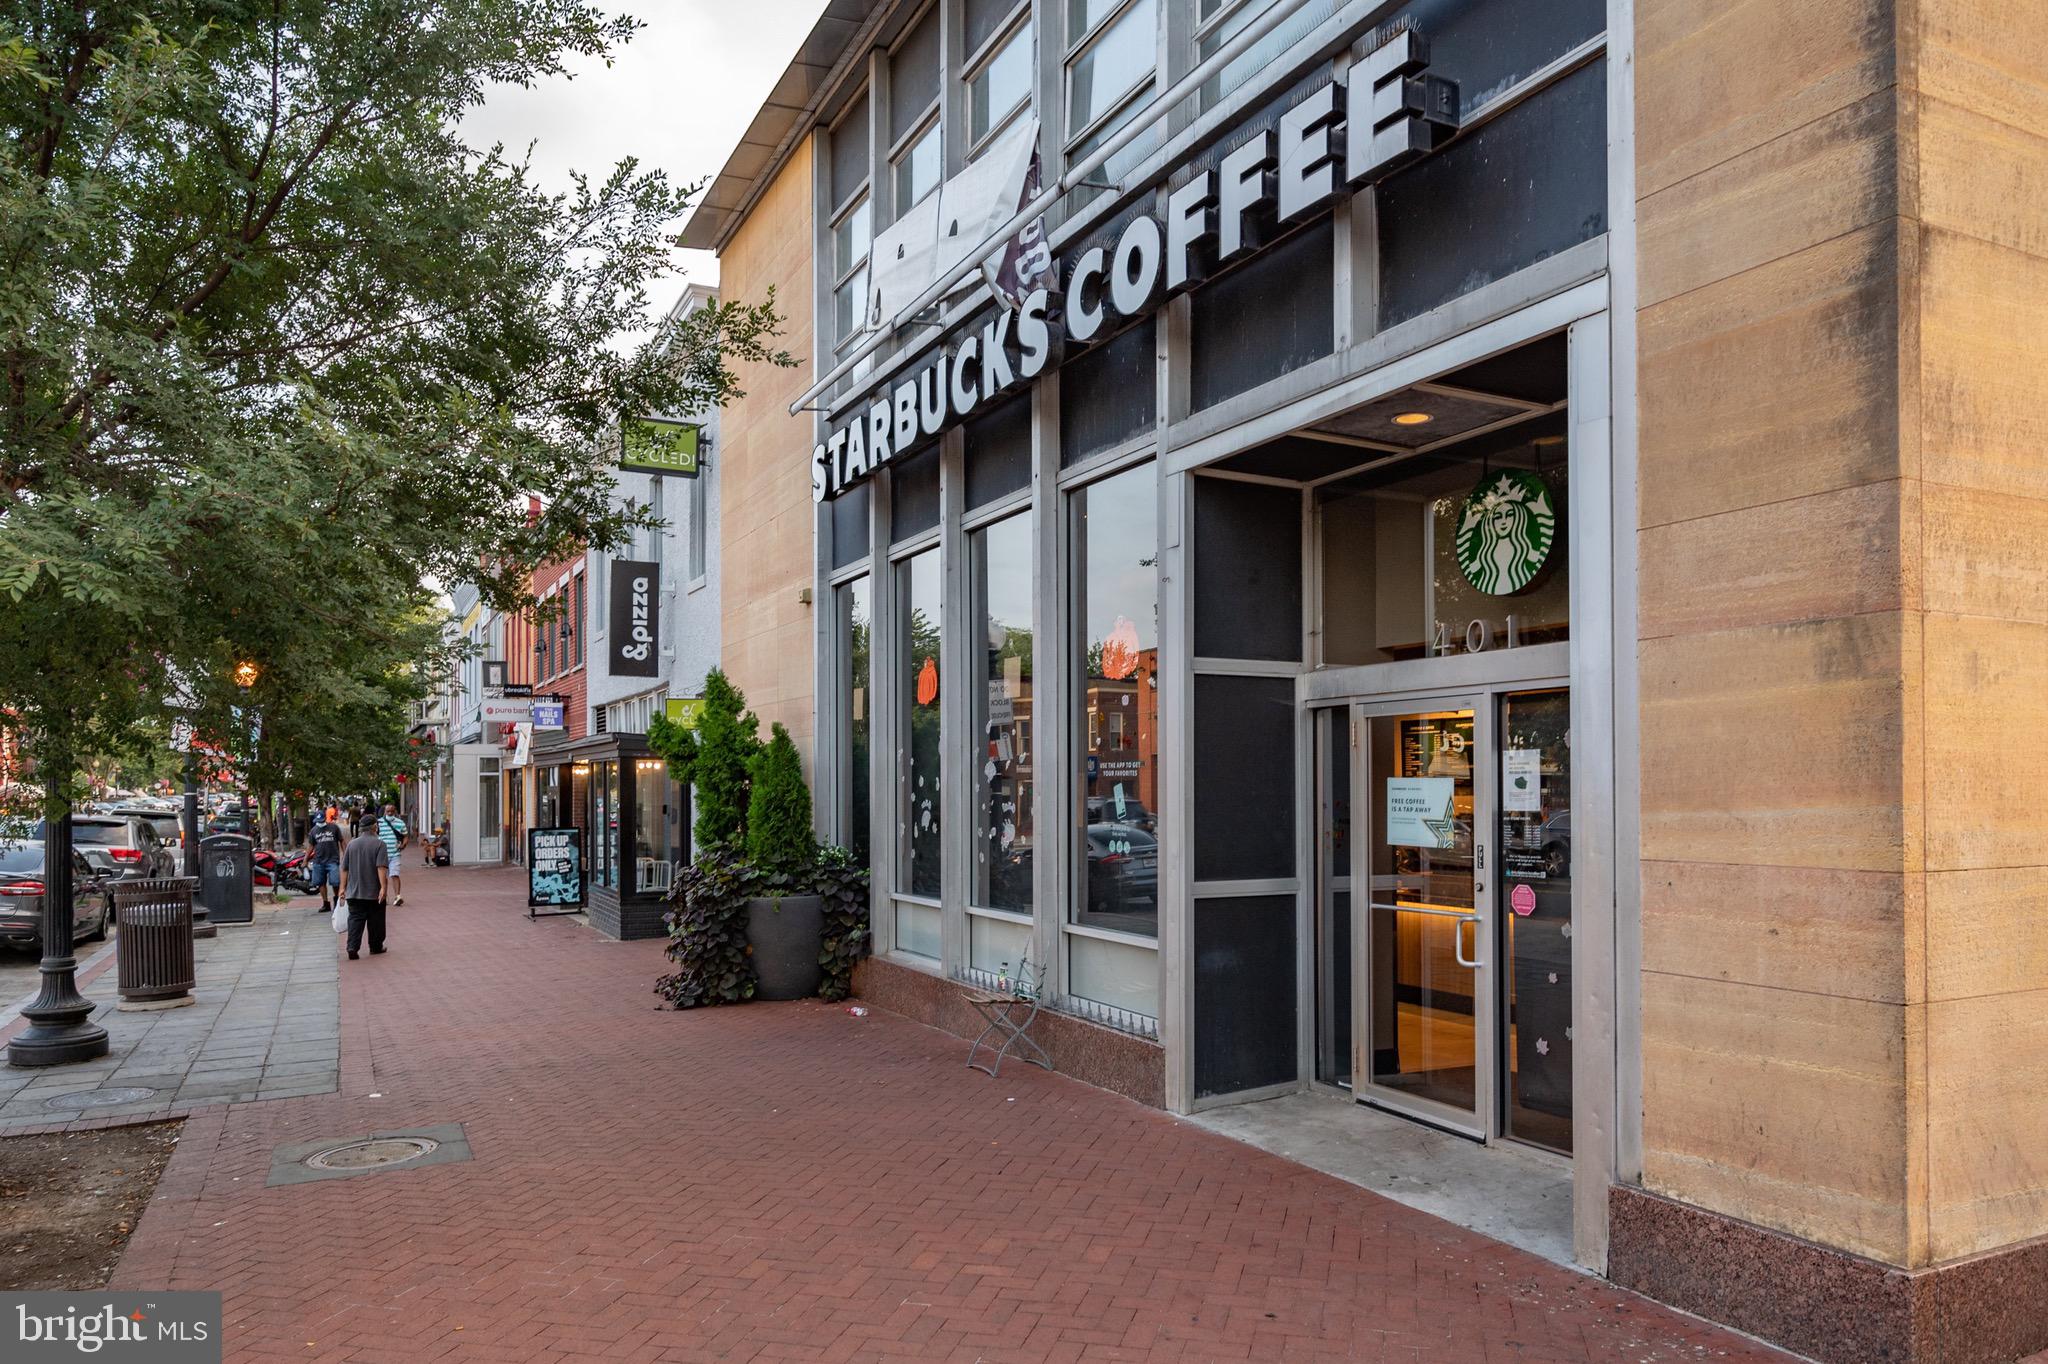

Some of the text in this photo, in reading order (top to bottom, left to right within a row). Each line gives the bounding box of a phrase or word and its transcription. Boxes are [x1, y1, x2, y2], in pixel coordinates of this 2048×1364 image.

[811, 29, 1411, 503] STARBUCKS COFFEE
[622, 577, 653, 661] &pizza
[1432, 614, 1512, 657] 401
[495, 705, 528, 714] pure barr
[535, 834, 569, 847] PICK UP
[535, 847, 570, 859] ORDERS
[535, 860, 558, 871] ONLY.
